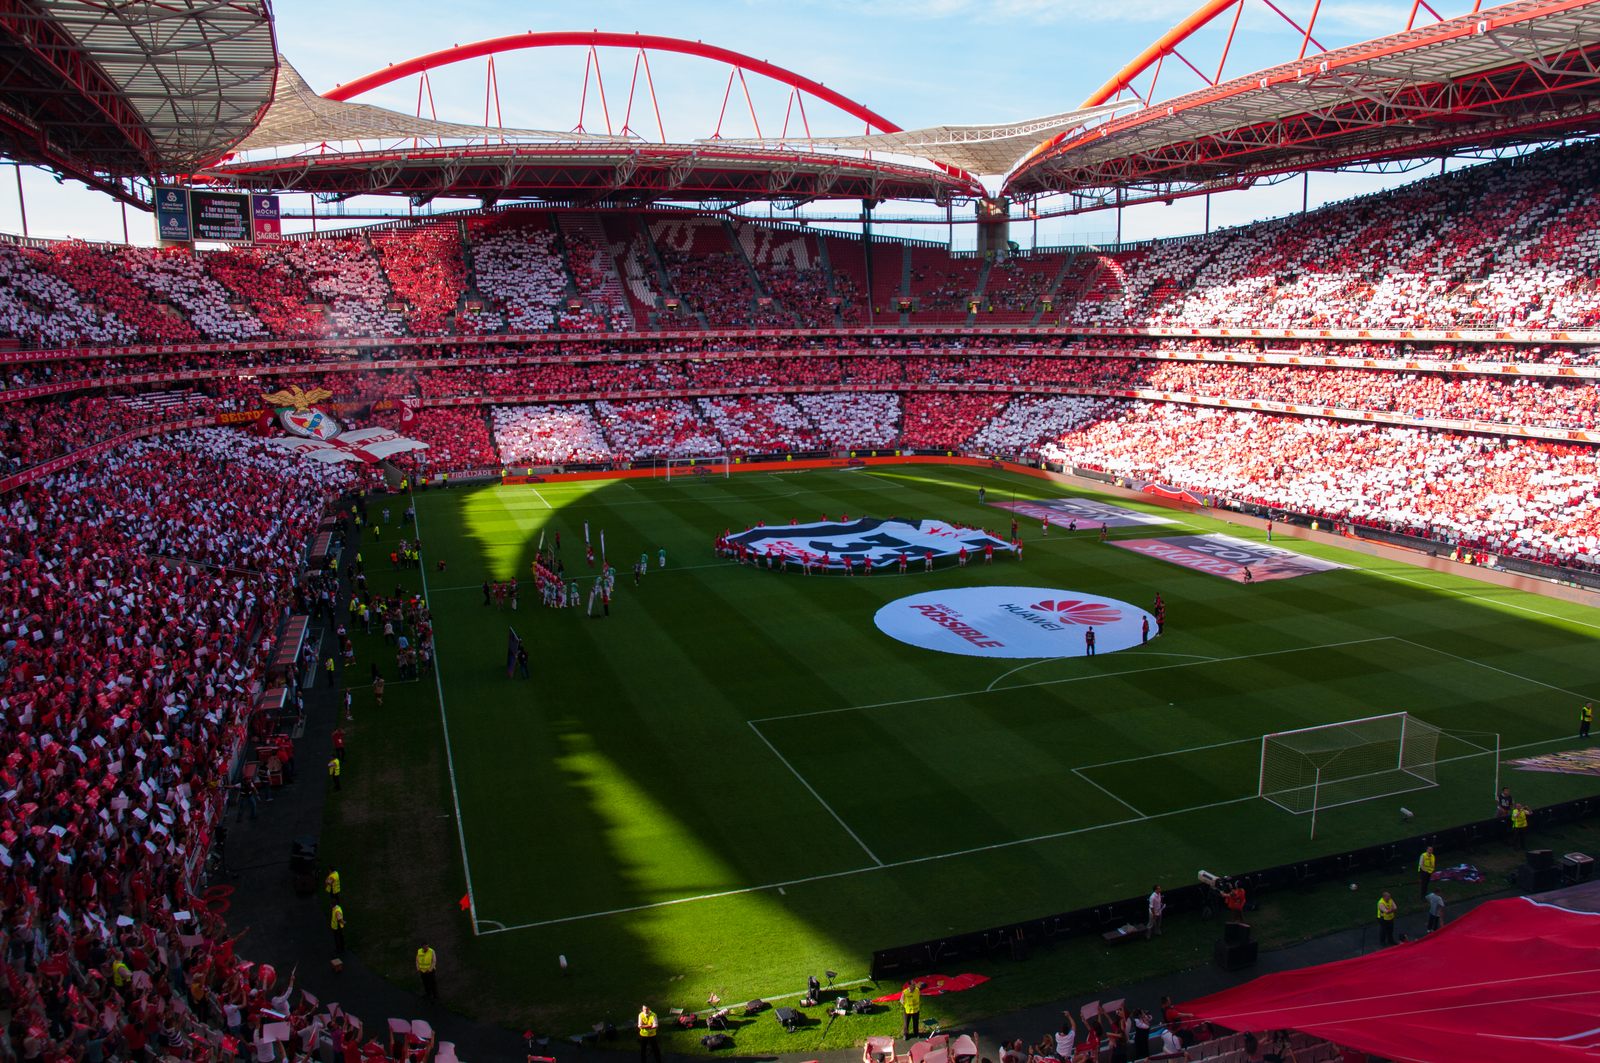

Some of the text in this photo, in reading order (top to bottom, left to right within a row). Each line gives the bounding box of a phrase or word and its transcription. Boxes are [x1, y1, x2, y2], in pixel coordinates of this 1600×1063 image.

[256, 231, 280, 241] SAGRES
[220, 410, 264, 423] SECTO
[1133, 544, 1240, 575] SAGRES
[908, 604, 1006, 648] POSSIBLE
[998, 603, 1065, 631] HUAWEI
